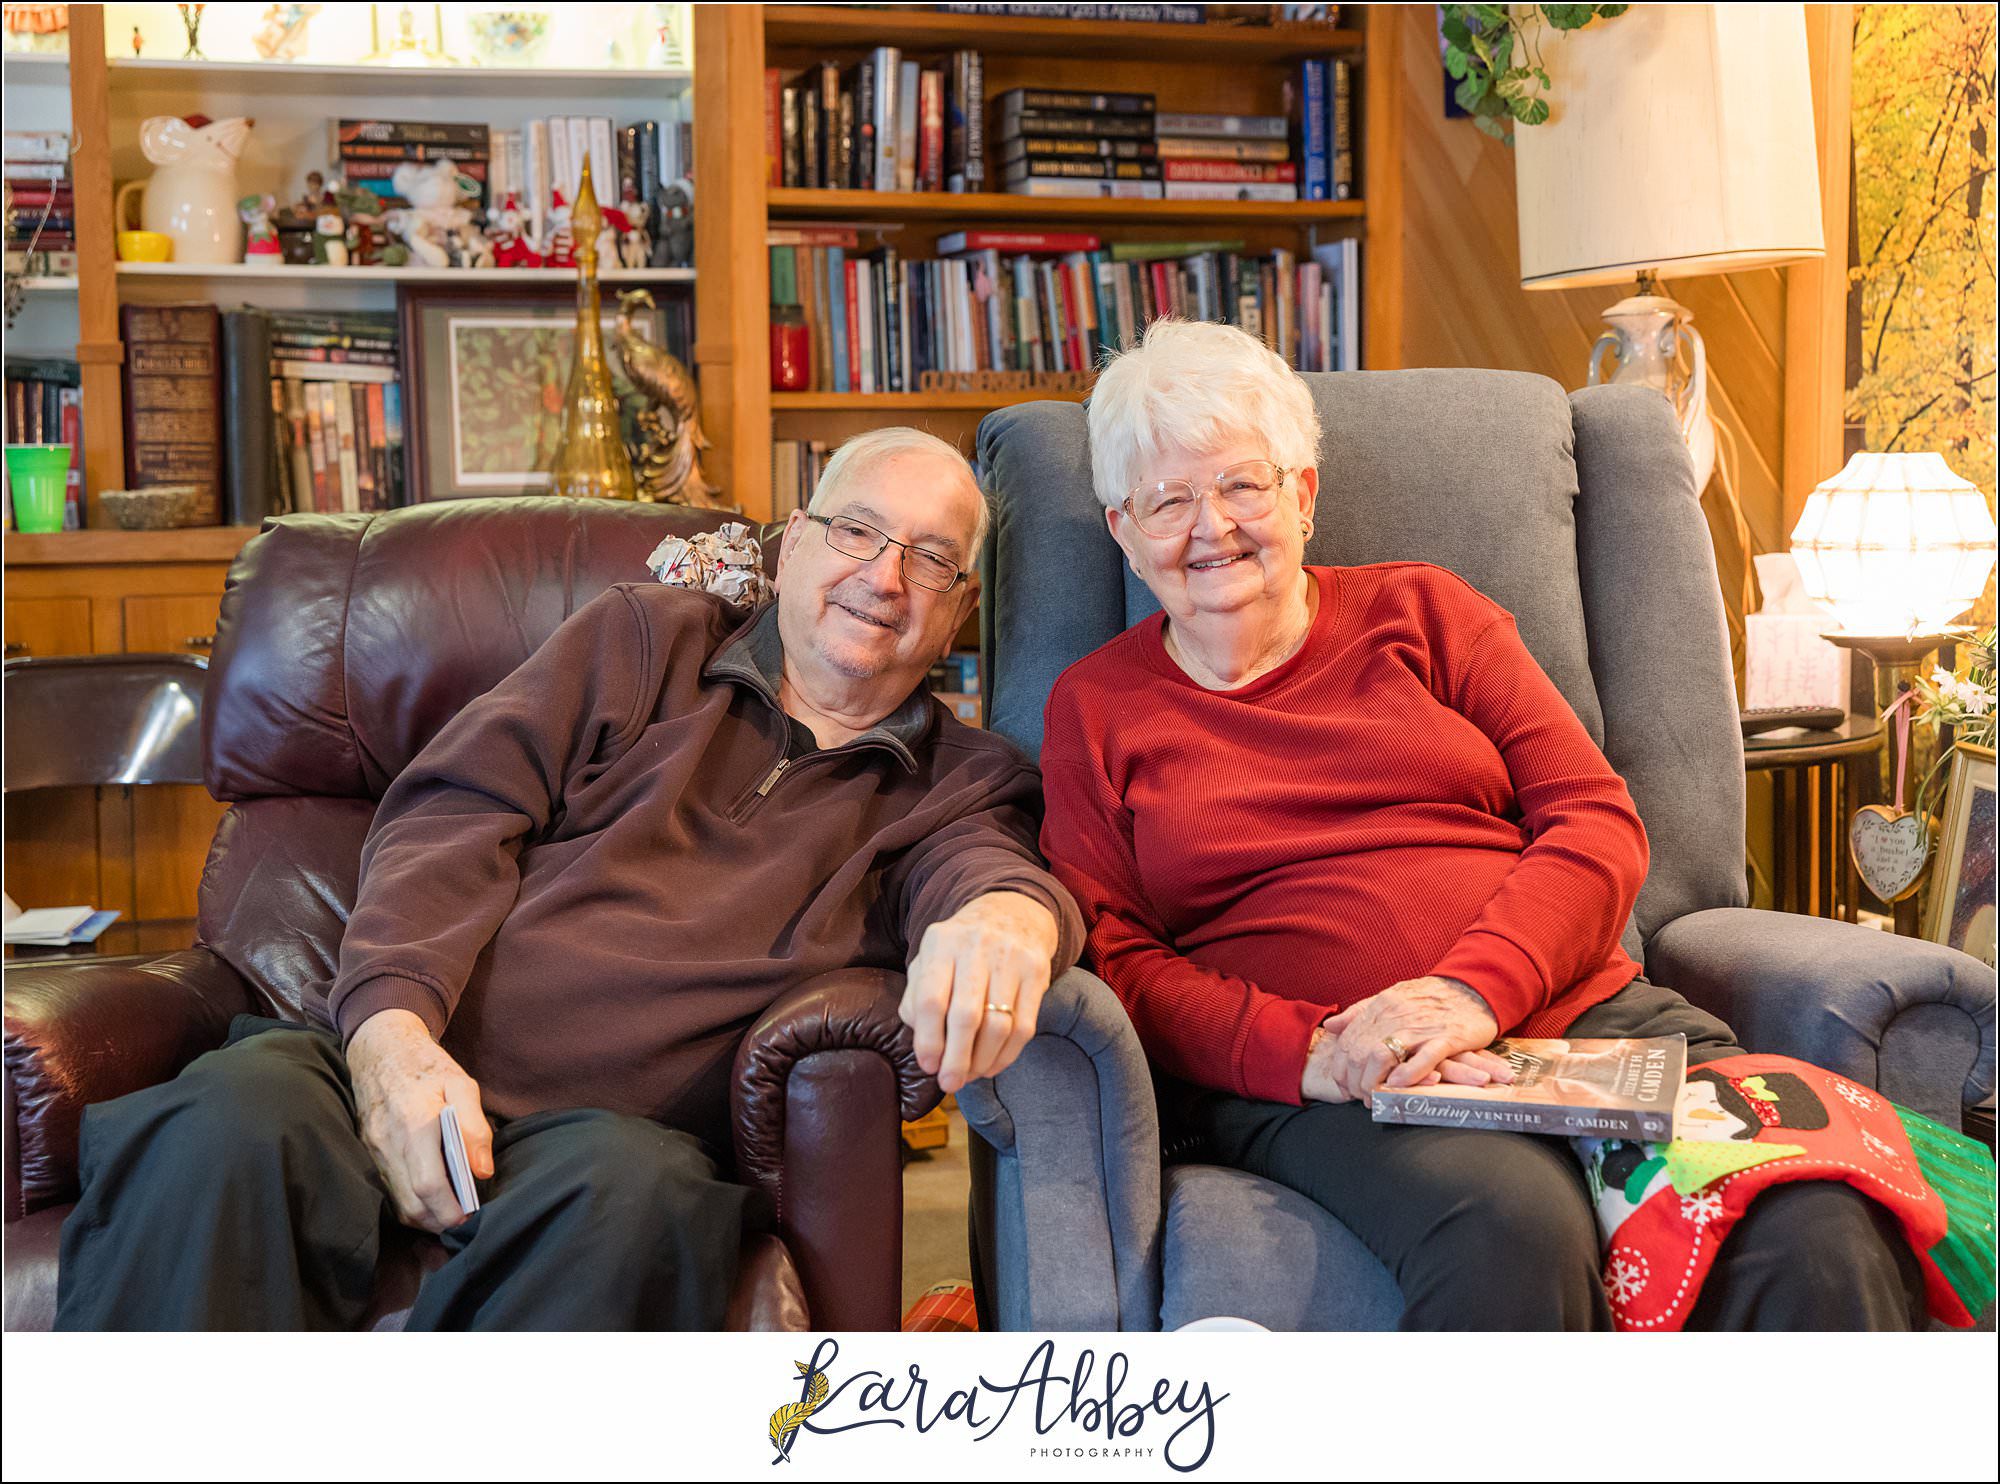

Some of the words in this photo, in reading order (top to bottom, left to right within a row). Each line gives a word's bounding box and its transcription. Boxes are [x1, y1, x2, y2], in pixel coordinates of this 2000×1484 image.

[1622, 1055, 1643, 1096] ELIZABETH
[1637, 1048, 1667, 1102] CAMDEN
[1392, 1106, 1401, 1114] A
[1404, 1096, 1471, 1126] Daring
[1473, 1111, 1543, 1125] VENTURE
[1564, 1115, 1630, 1131] CAMDEN
